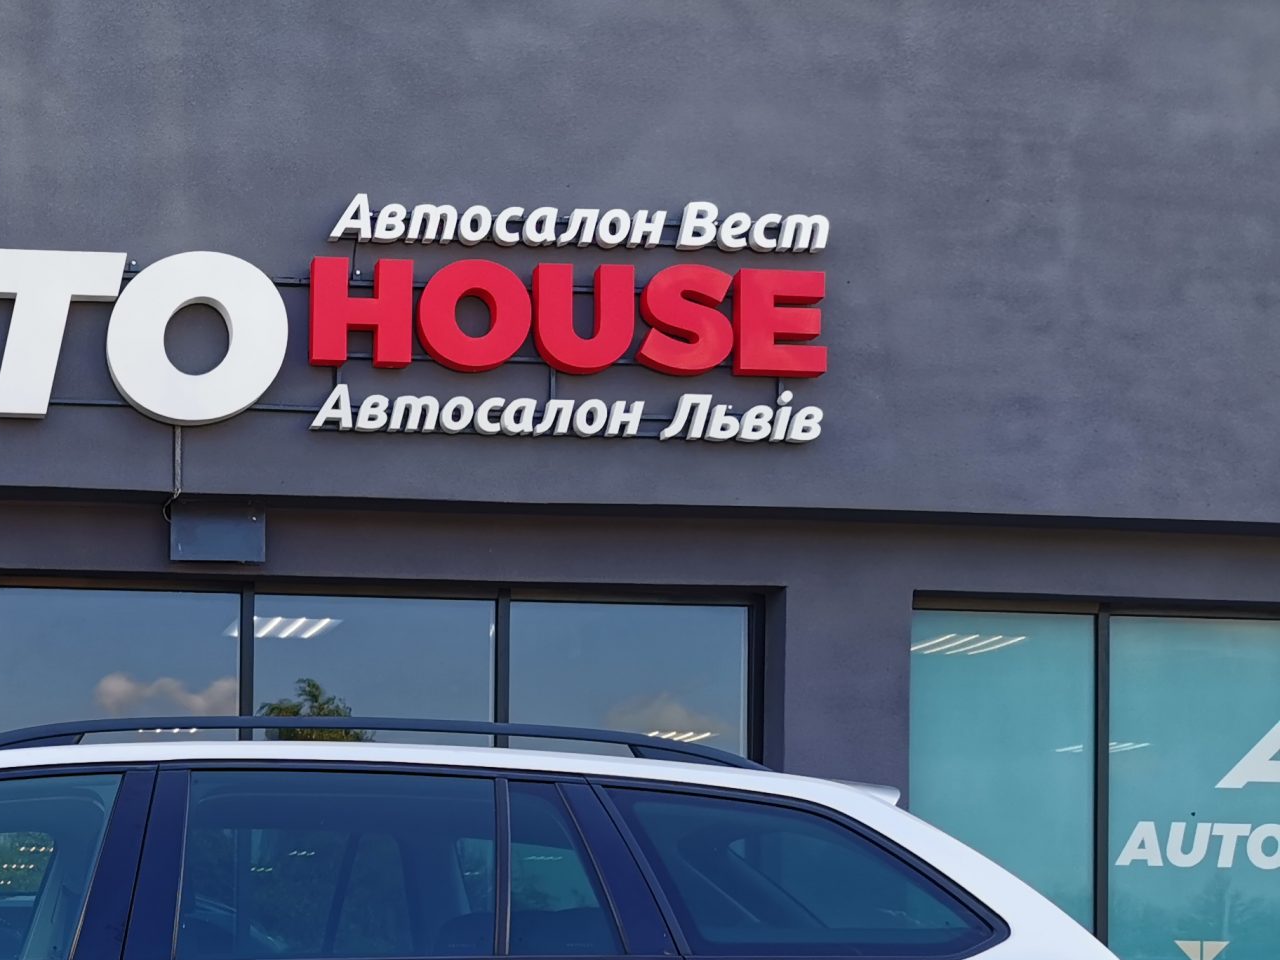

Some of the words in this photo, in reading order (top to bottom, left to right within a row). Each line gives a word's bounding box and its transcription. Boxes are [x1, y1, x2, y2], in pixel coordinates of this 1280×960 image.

[329, 193, 667, 249] Автосалон
[675, 201, 831, 254] Вест
[308, 256, 828, 377] HOUSE
[310, 383, 646, 437] Автосалон
[659, 389, 825, 444] Львів
